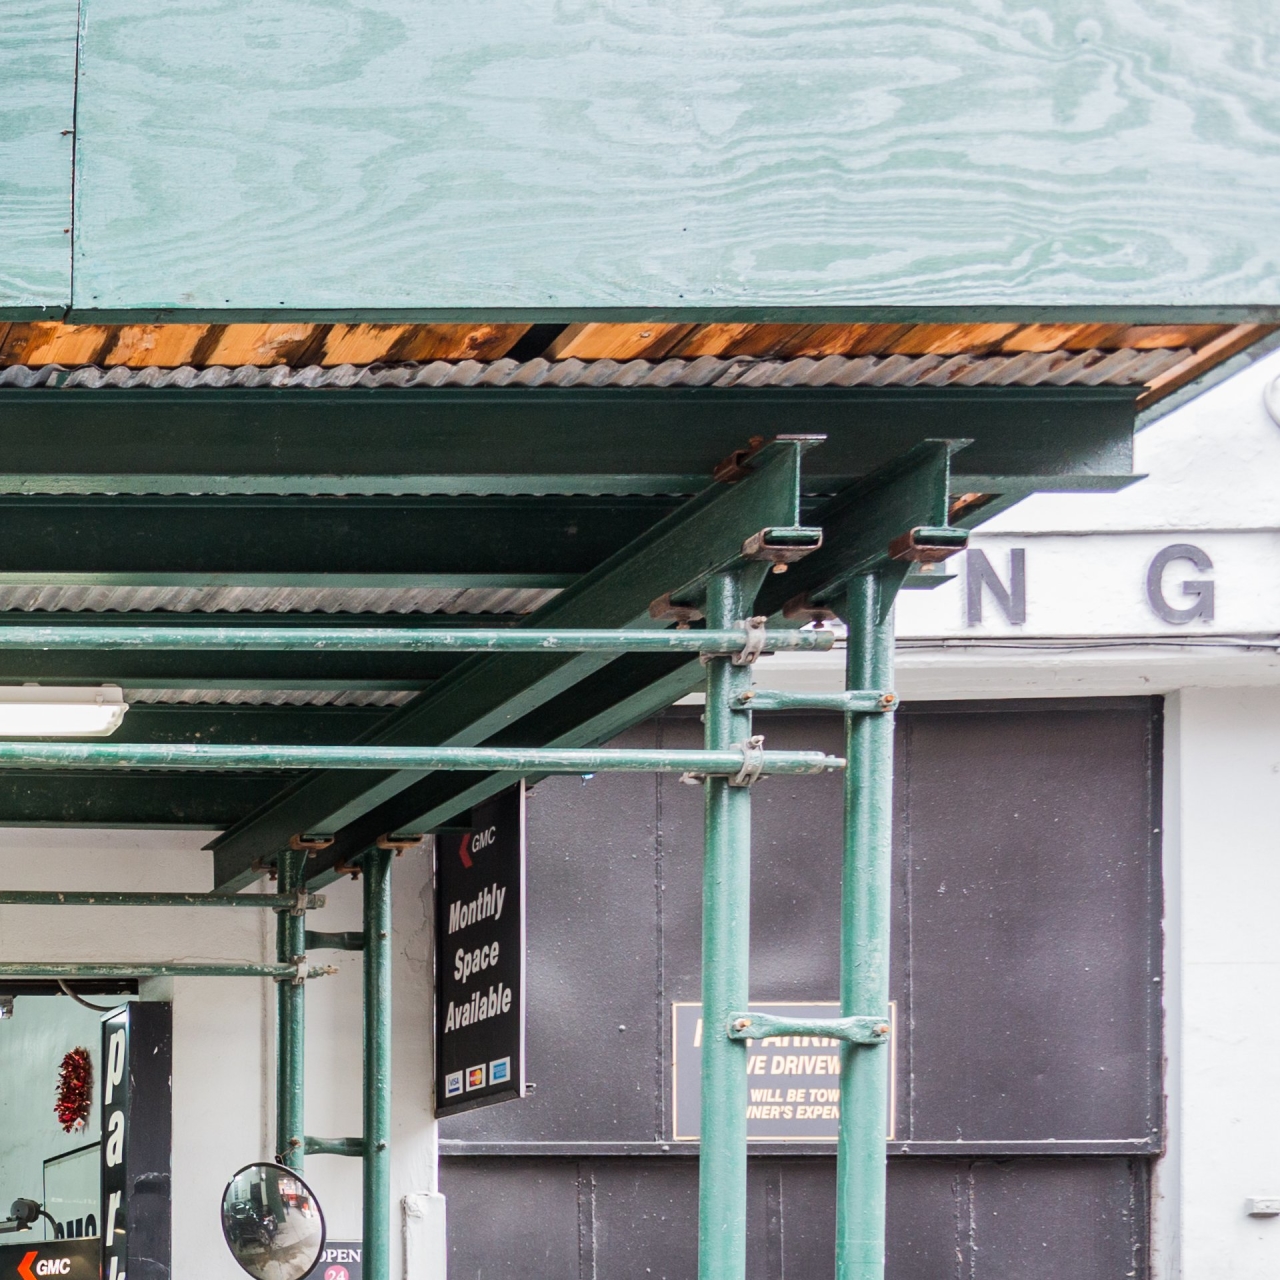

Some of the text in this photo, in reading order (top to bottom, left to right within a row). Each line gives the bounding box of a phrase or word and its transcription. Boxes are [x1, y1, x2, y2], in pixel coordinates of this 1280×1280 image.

[471, 825, 497, 853] GMC
[448, 882, 507, 934] Monthly
[454, 941, 500, 983] Space
[444, 982, 513, 1034] Available
[771, 1055, 841, 1075] DRIVEW
[750, 1088, 841, 1103] WILL BE TOW
[746, 1104, 840, 1120] NER'S EXPEN
[36, 1258, 71, 1276] GMC
